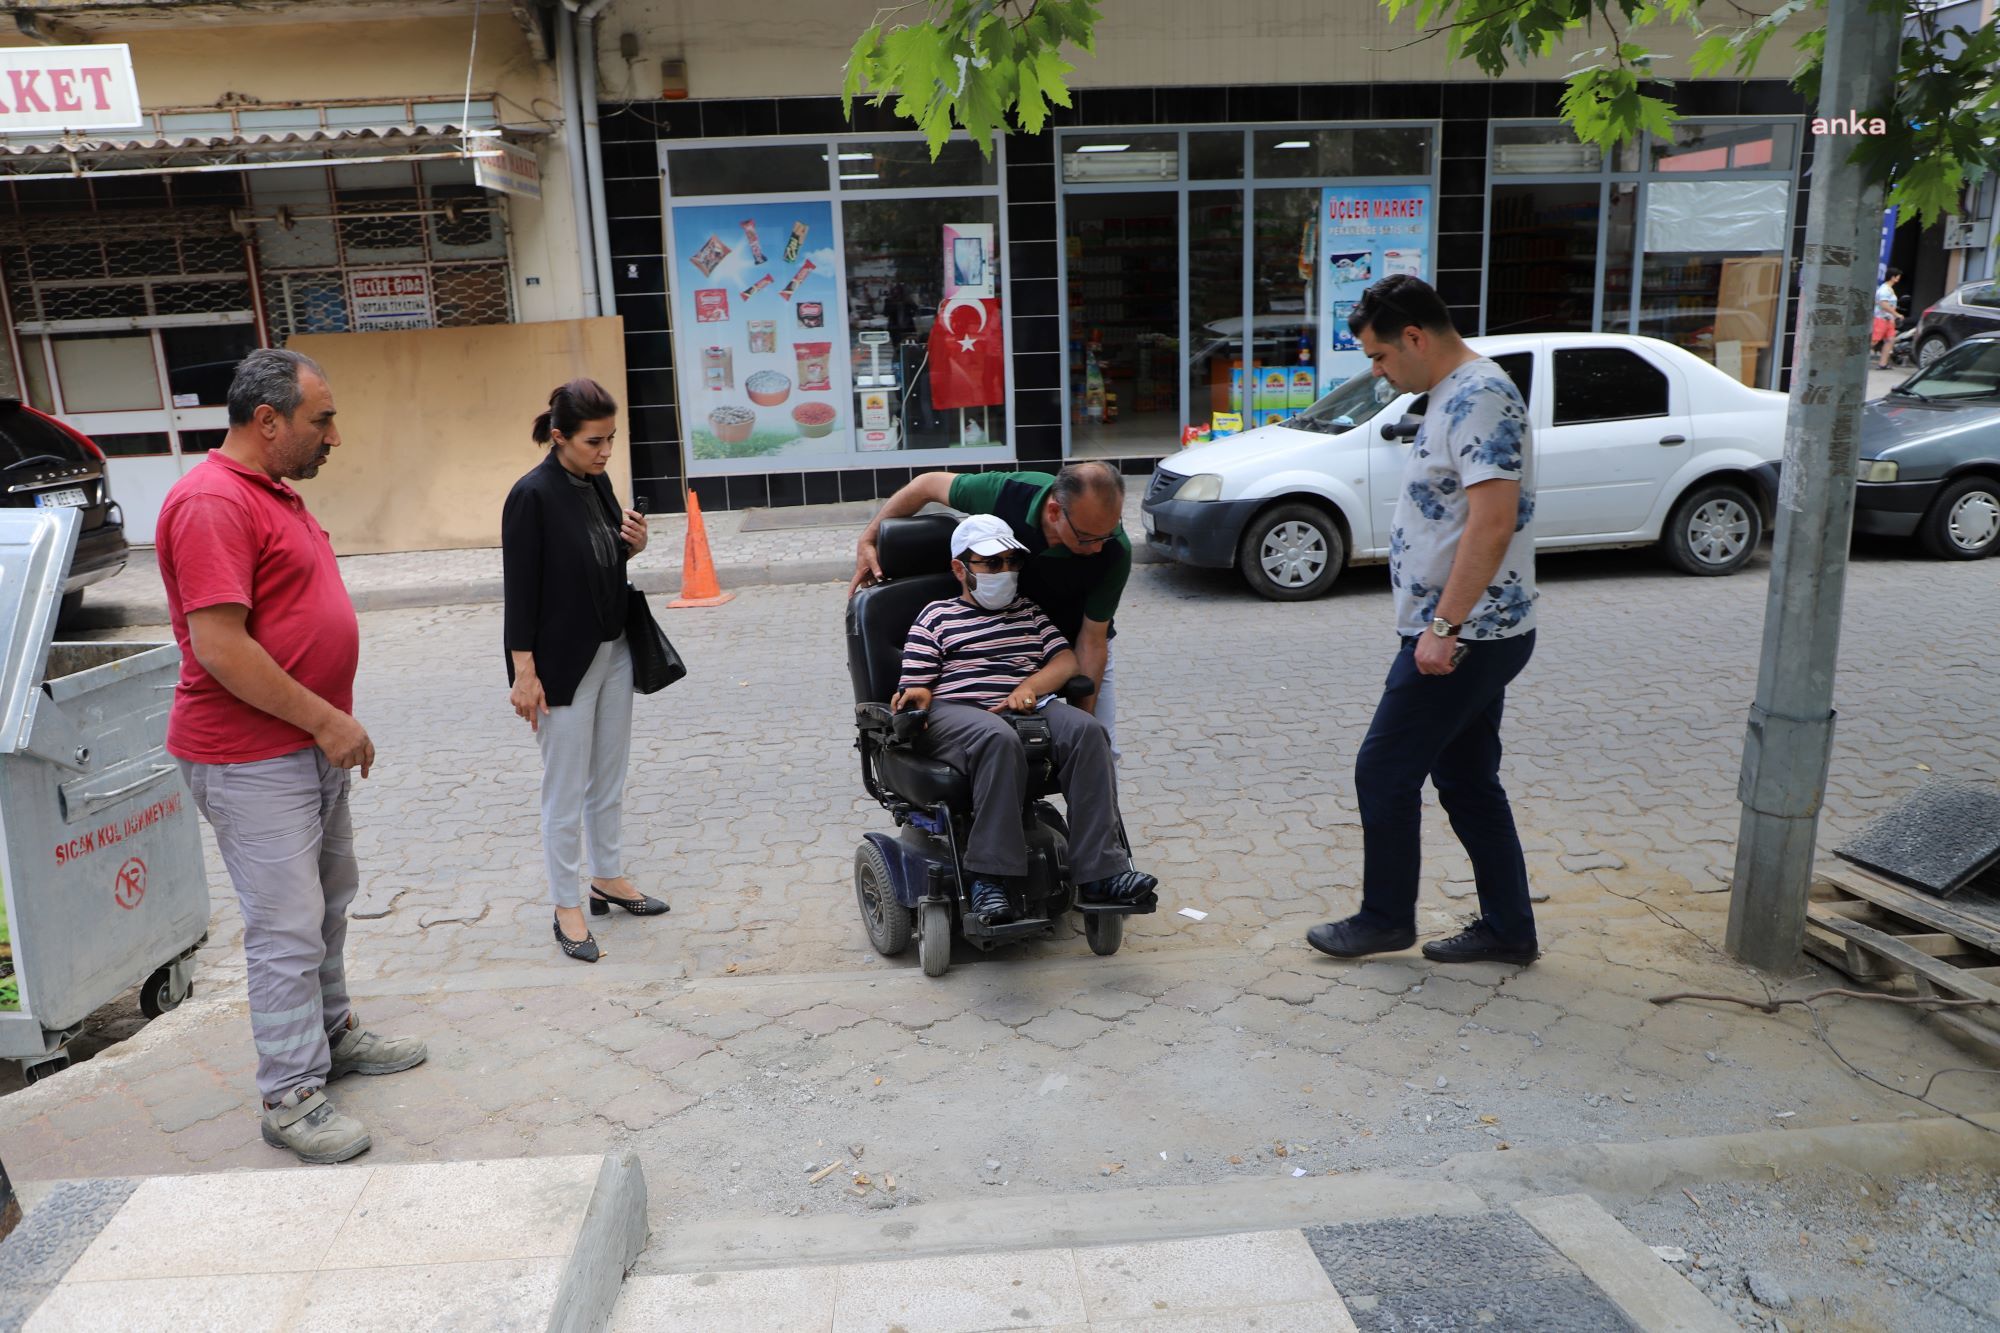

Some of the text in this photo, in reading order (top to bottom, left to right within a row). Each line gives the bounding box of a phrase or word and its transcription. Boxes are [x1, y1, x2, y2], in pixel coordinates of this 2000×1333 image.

[1329, 196, 1424, 224] ÜÇLER MARKET
[55, 831, 95, 866] SICAK
